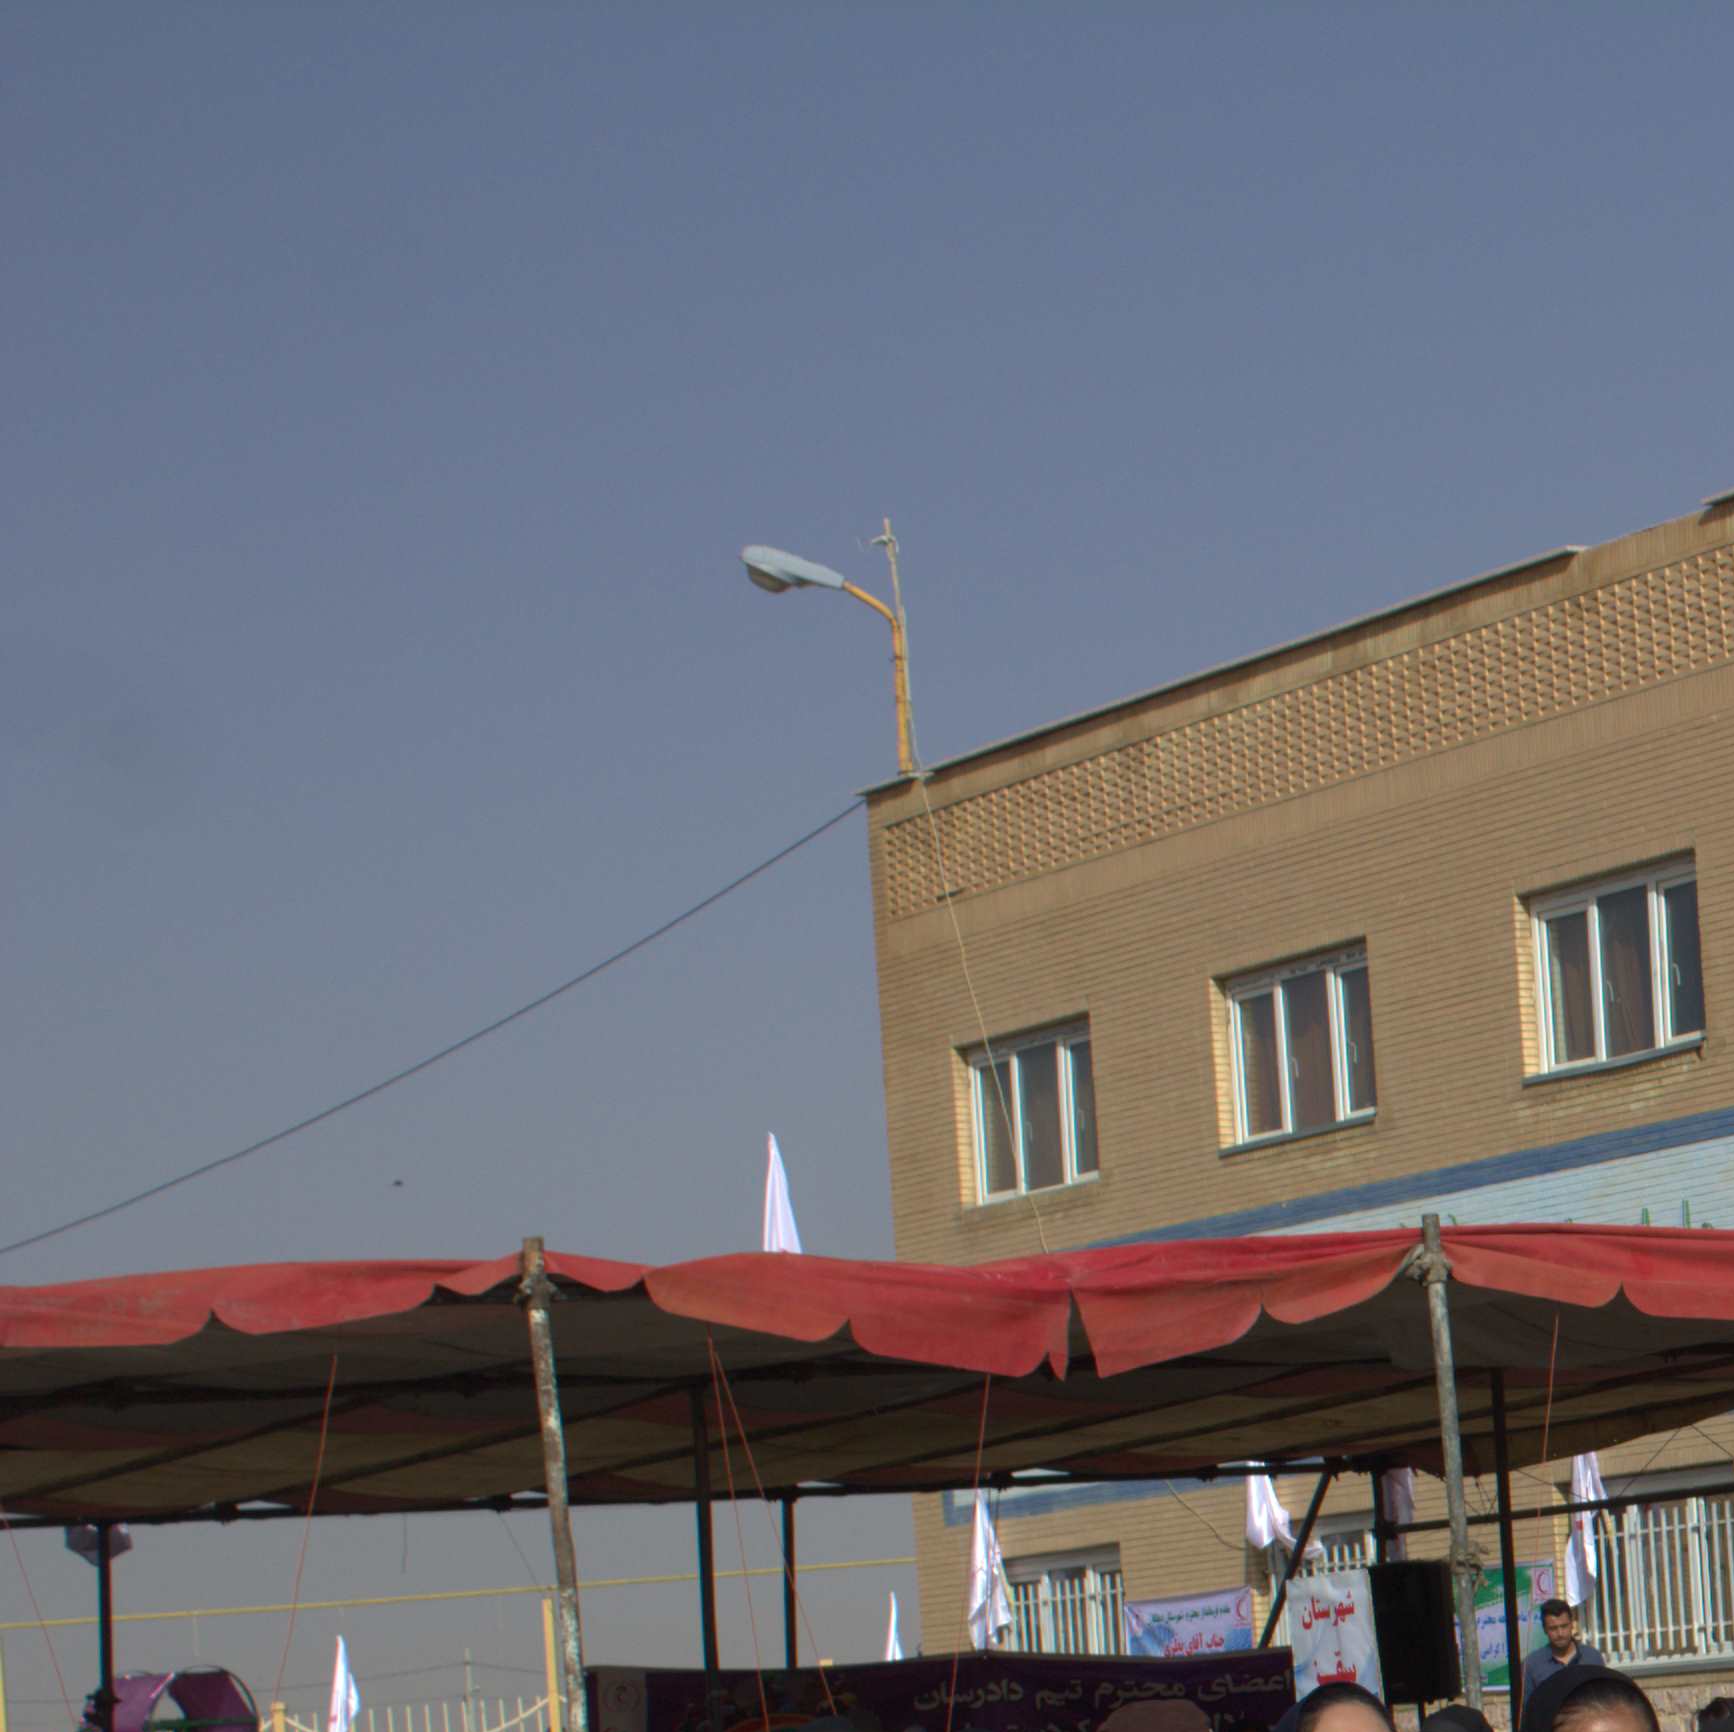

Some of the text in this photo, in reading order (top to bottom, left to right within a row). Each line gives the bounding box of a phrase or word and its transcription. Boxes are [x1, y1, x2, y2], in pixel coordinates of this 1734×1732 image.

[1300, 1590, 1356, 1631] شهرستان
[912, 1677, 1025, 1712] دادرسان
[1034, 1678, 1083, 1711] تیم
[1093, 1679, 1187, 1711] محترم
